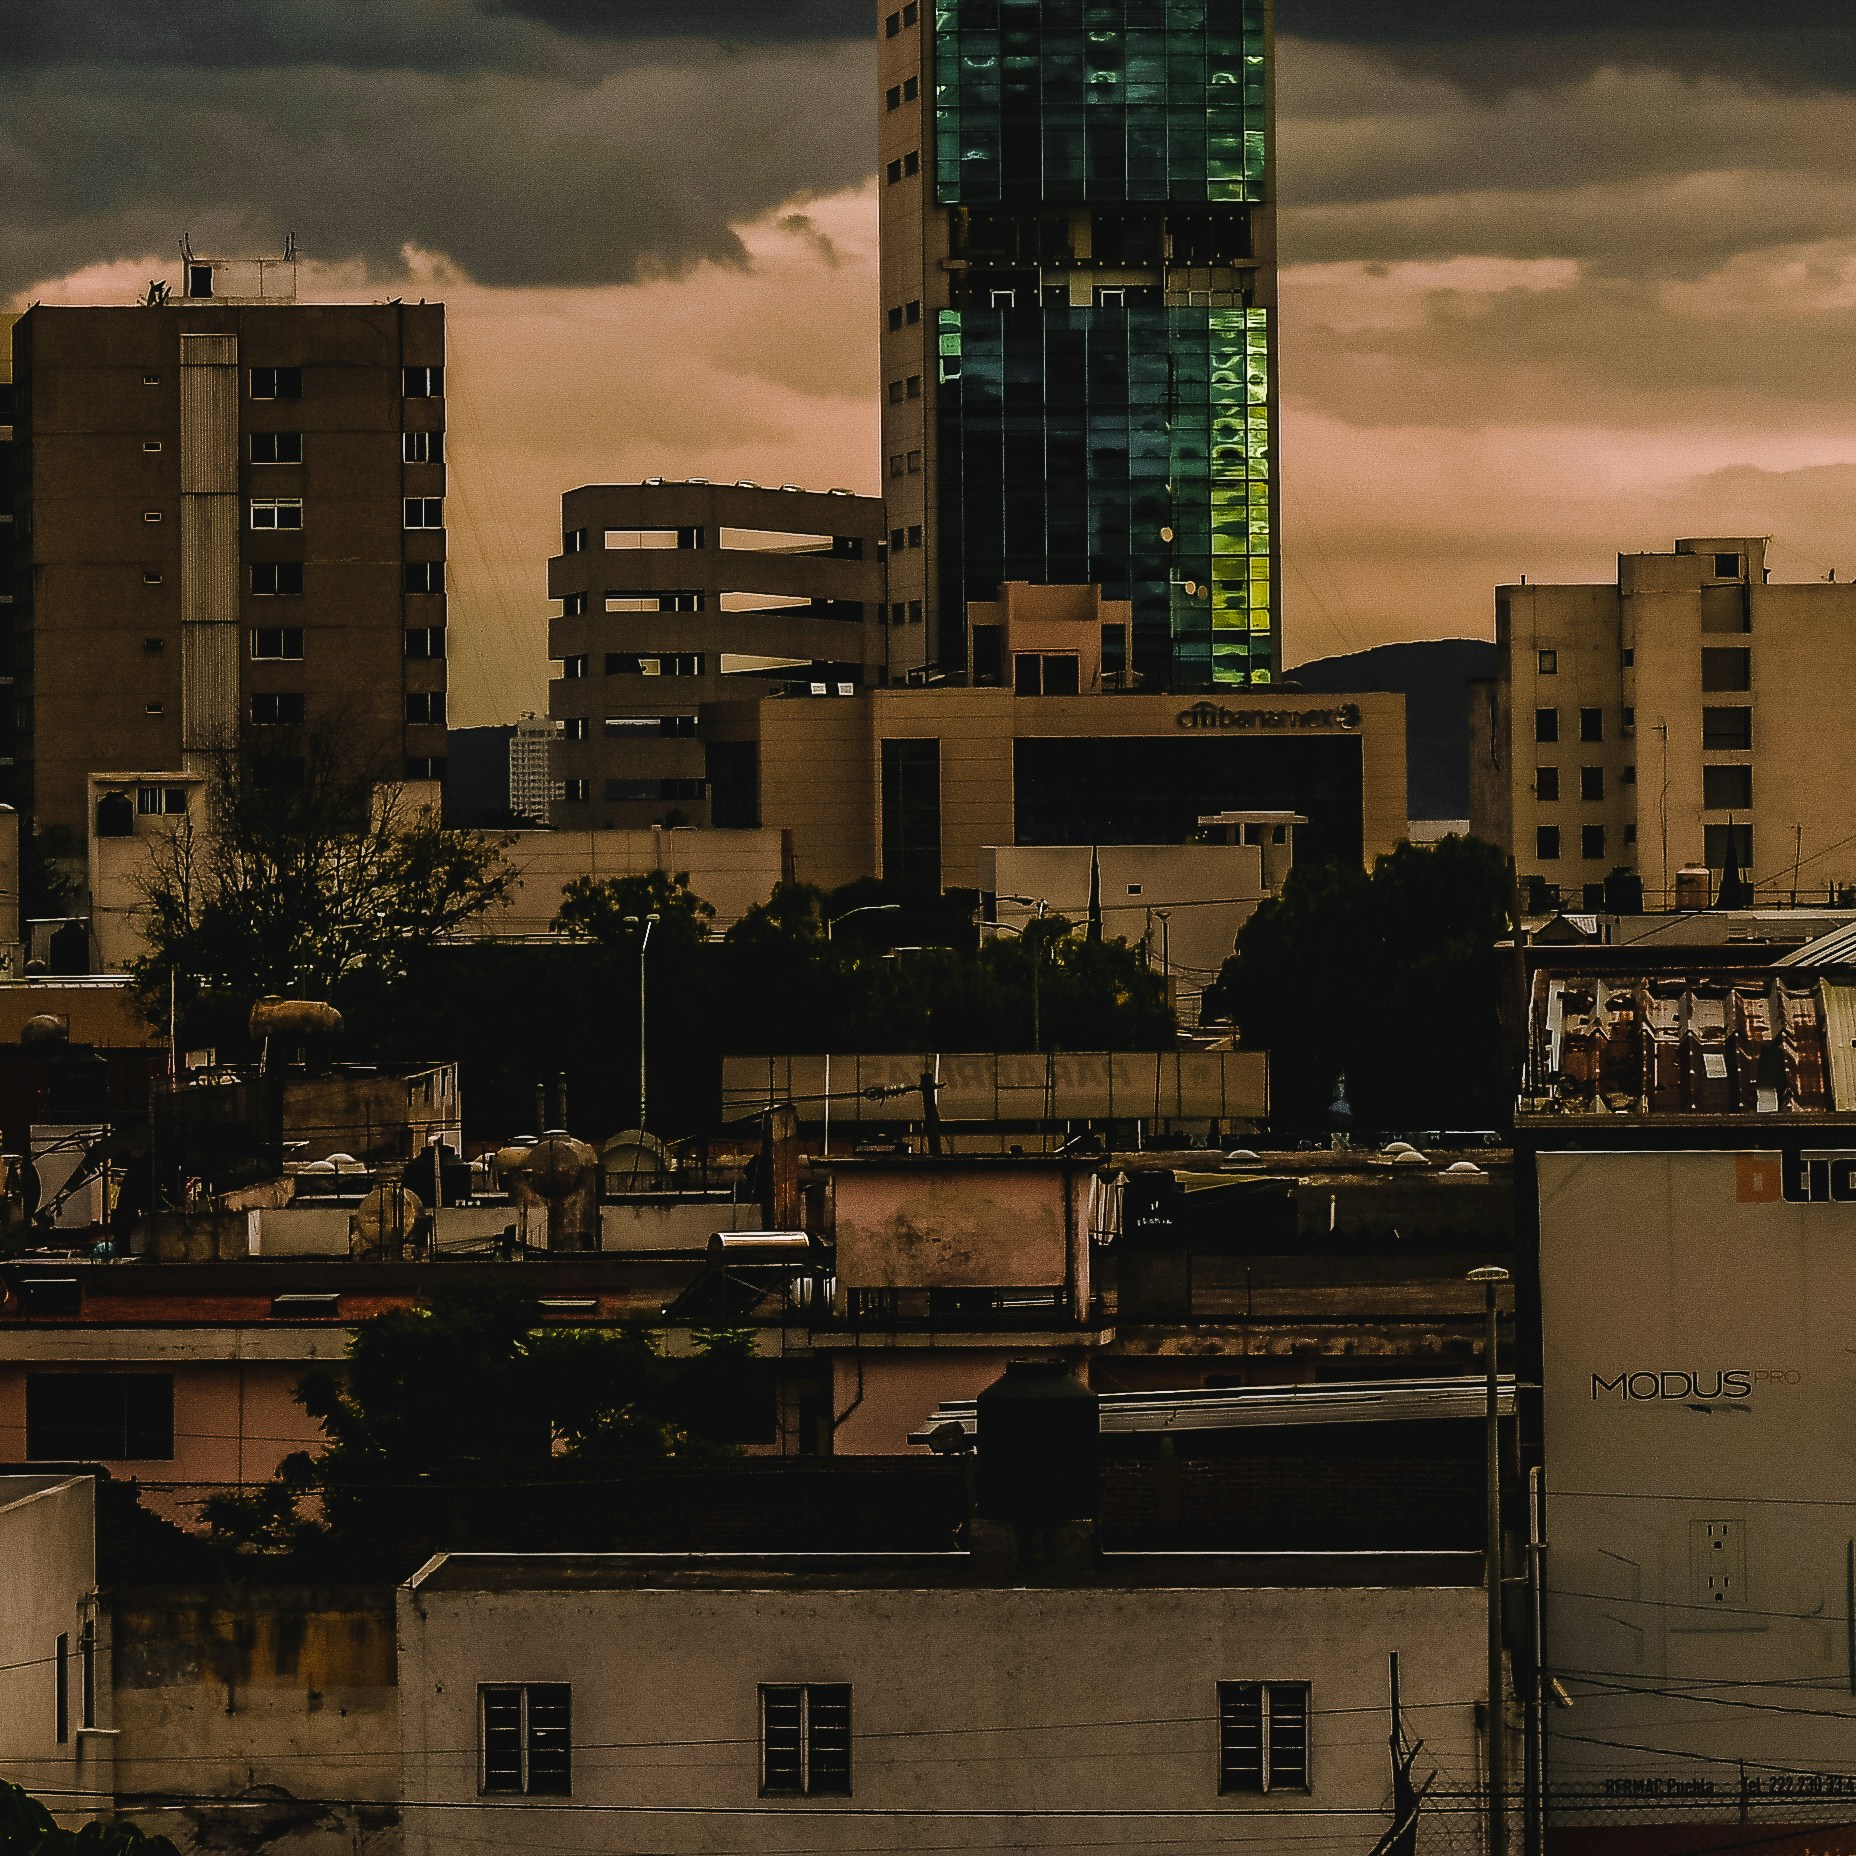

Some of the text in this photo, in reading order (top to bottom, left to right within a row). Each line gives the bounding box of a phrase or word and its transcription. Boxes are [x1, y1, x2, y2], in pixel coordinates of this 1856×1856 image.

[1177, 702, 1334, 729] citibanamex
[1590, 1368, 1802, 1401] MODUS PRO
[1667, 1777, 1715, 1795] Puebla
